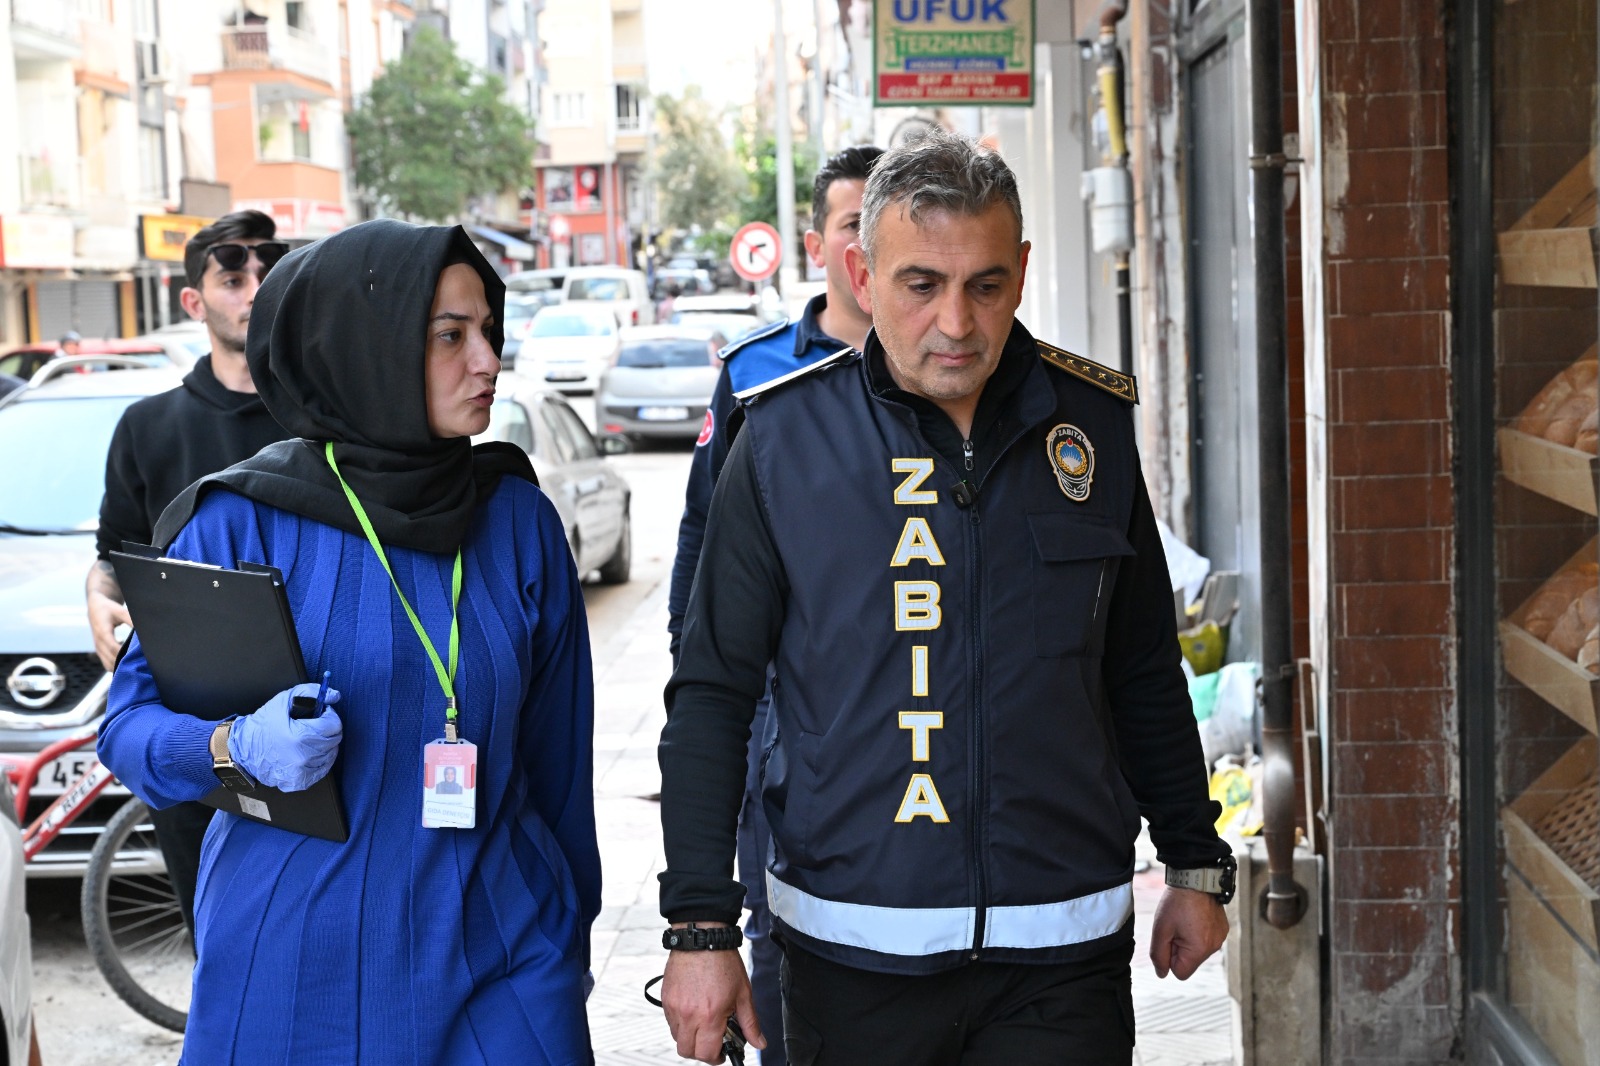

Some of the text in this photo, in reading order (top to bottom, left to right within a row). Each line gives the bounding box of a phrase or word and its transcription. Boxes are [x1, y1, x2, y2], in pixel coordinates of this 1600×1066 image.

[894, 0, 1007, 22] UFUK
[1057, 428, 1082, 441] ZABITA
[890, 458, 950, 822] ZABITA
